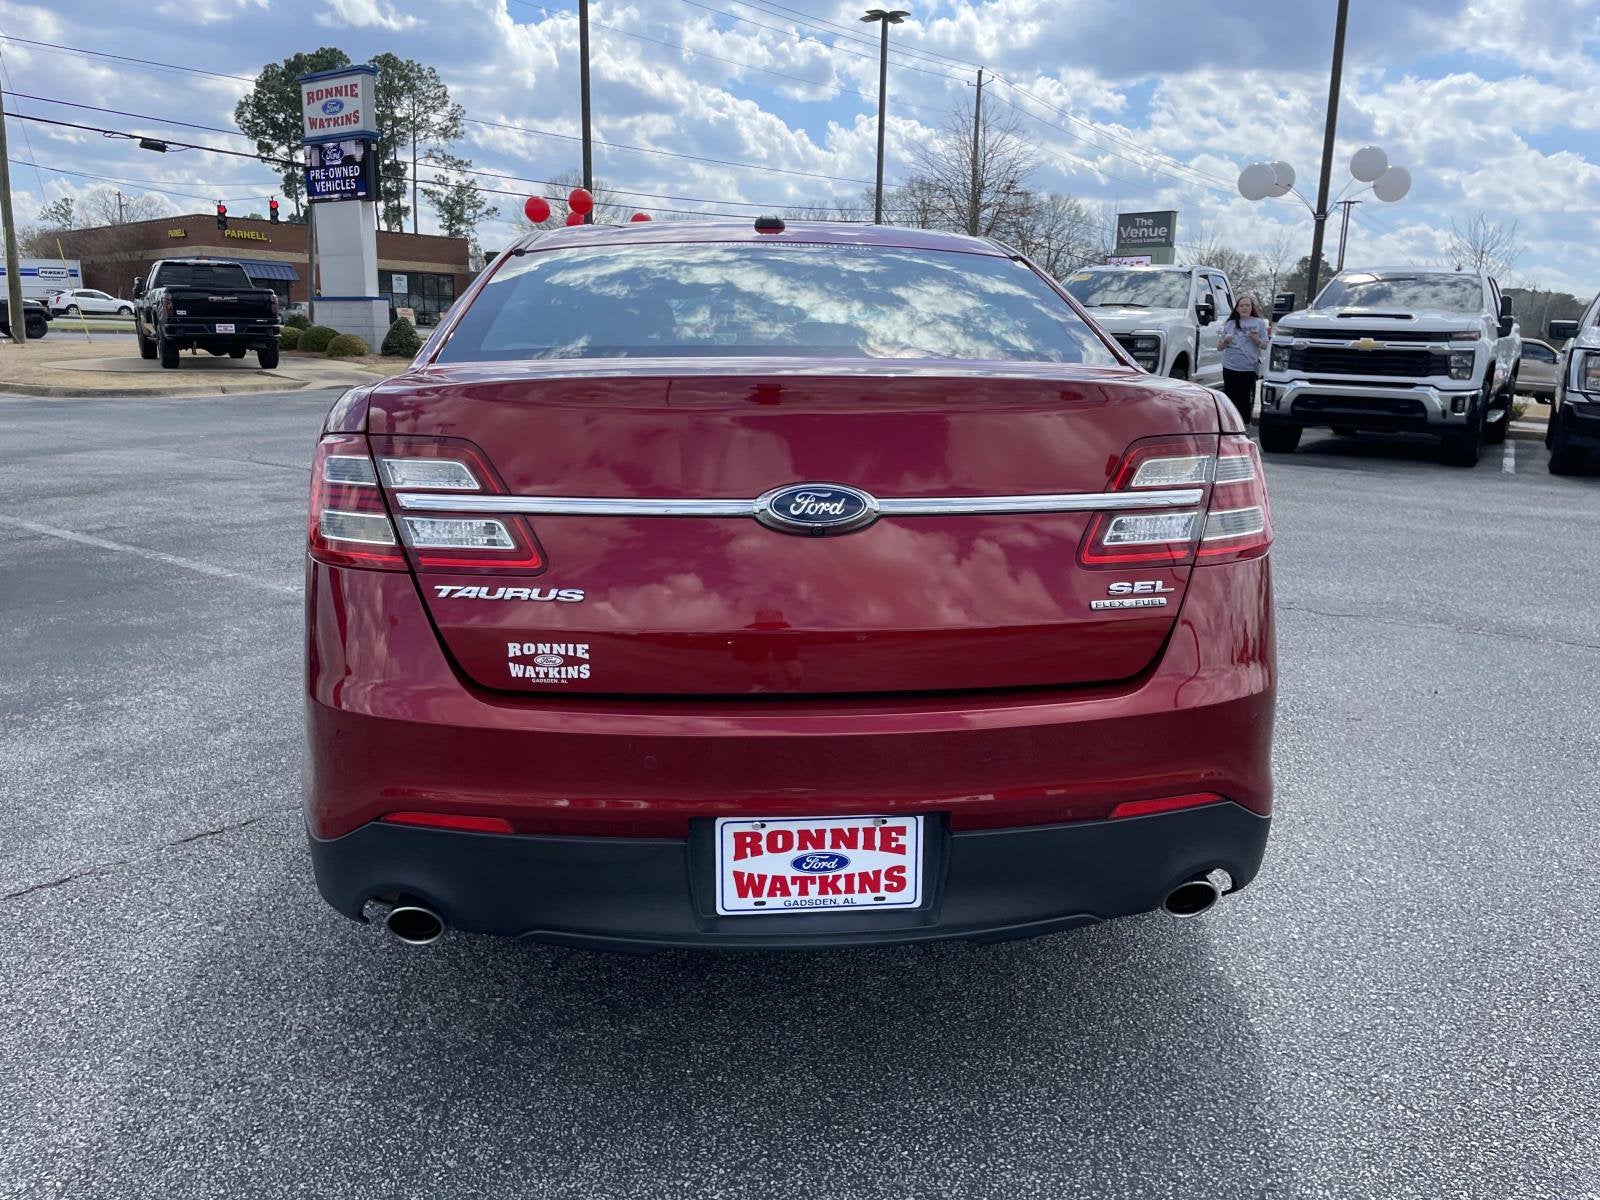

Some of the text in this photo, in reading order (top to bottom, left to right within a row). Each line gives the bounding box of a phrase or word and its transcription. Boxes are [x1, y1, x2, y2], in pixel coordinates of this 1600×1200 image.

[306, 83, 359, 106] RONNIE
[325, 101, 341, 114] Ford
[308, 110, 360, 130] WATKINS
[325, 148, 341, 161] Ford
[310, 165, 360, 181] PRE-OWNED
[315, 179, 356, 192] VEHICLES
[1134, 217, 1154, 226] The
[224, 229, 268, 241] PARNELL
[1120, 226, 1168, 238] Venue
[789, 491, 846, 516] Ford
[434, 585, 585, 602] TAURUS
[1108, 580, 1175, 596] SEL
[1095, 598, 1166, 608] FLEX FUEL
[507, 642, 590, 660] RONNIE
[508, 662, 591, 679] WATKINS
[733, 825, 907, 861] RONNIE
[802, 855, 838, 870] Ford
[732, 864, 907, 899] WATKINS
[783, 897, 857, 908] GADSDEN, AL
